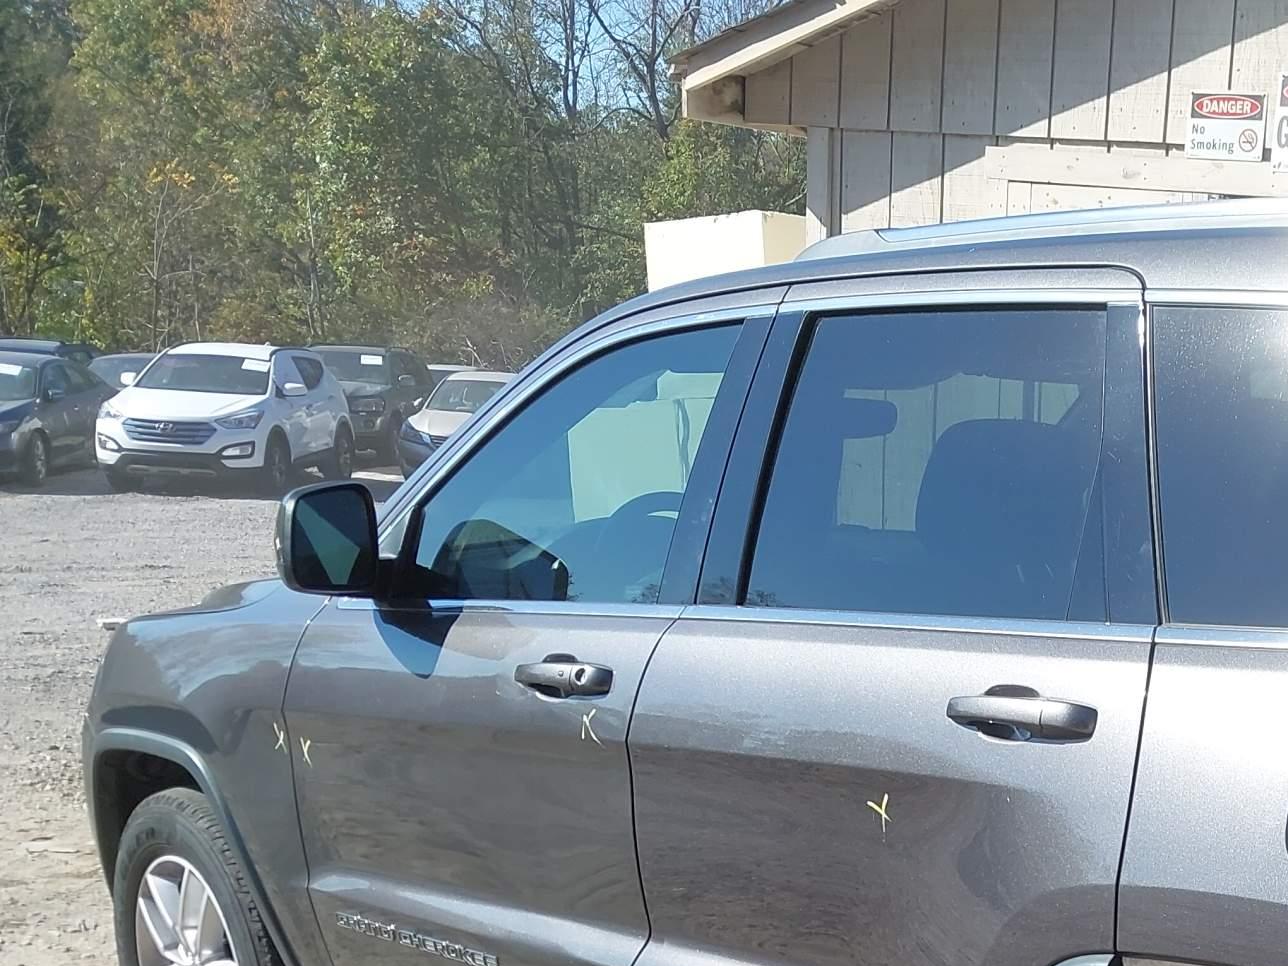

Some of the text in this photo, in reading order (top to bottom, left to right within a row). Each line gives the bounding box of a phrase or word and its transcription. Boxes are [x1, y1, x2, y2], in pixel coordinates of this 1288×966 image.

[1202, 100, 1252, 115] DANGER
[1191, 123, 1206, 136] No
[1190, 138, 1235, 155] Smoking
